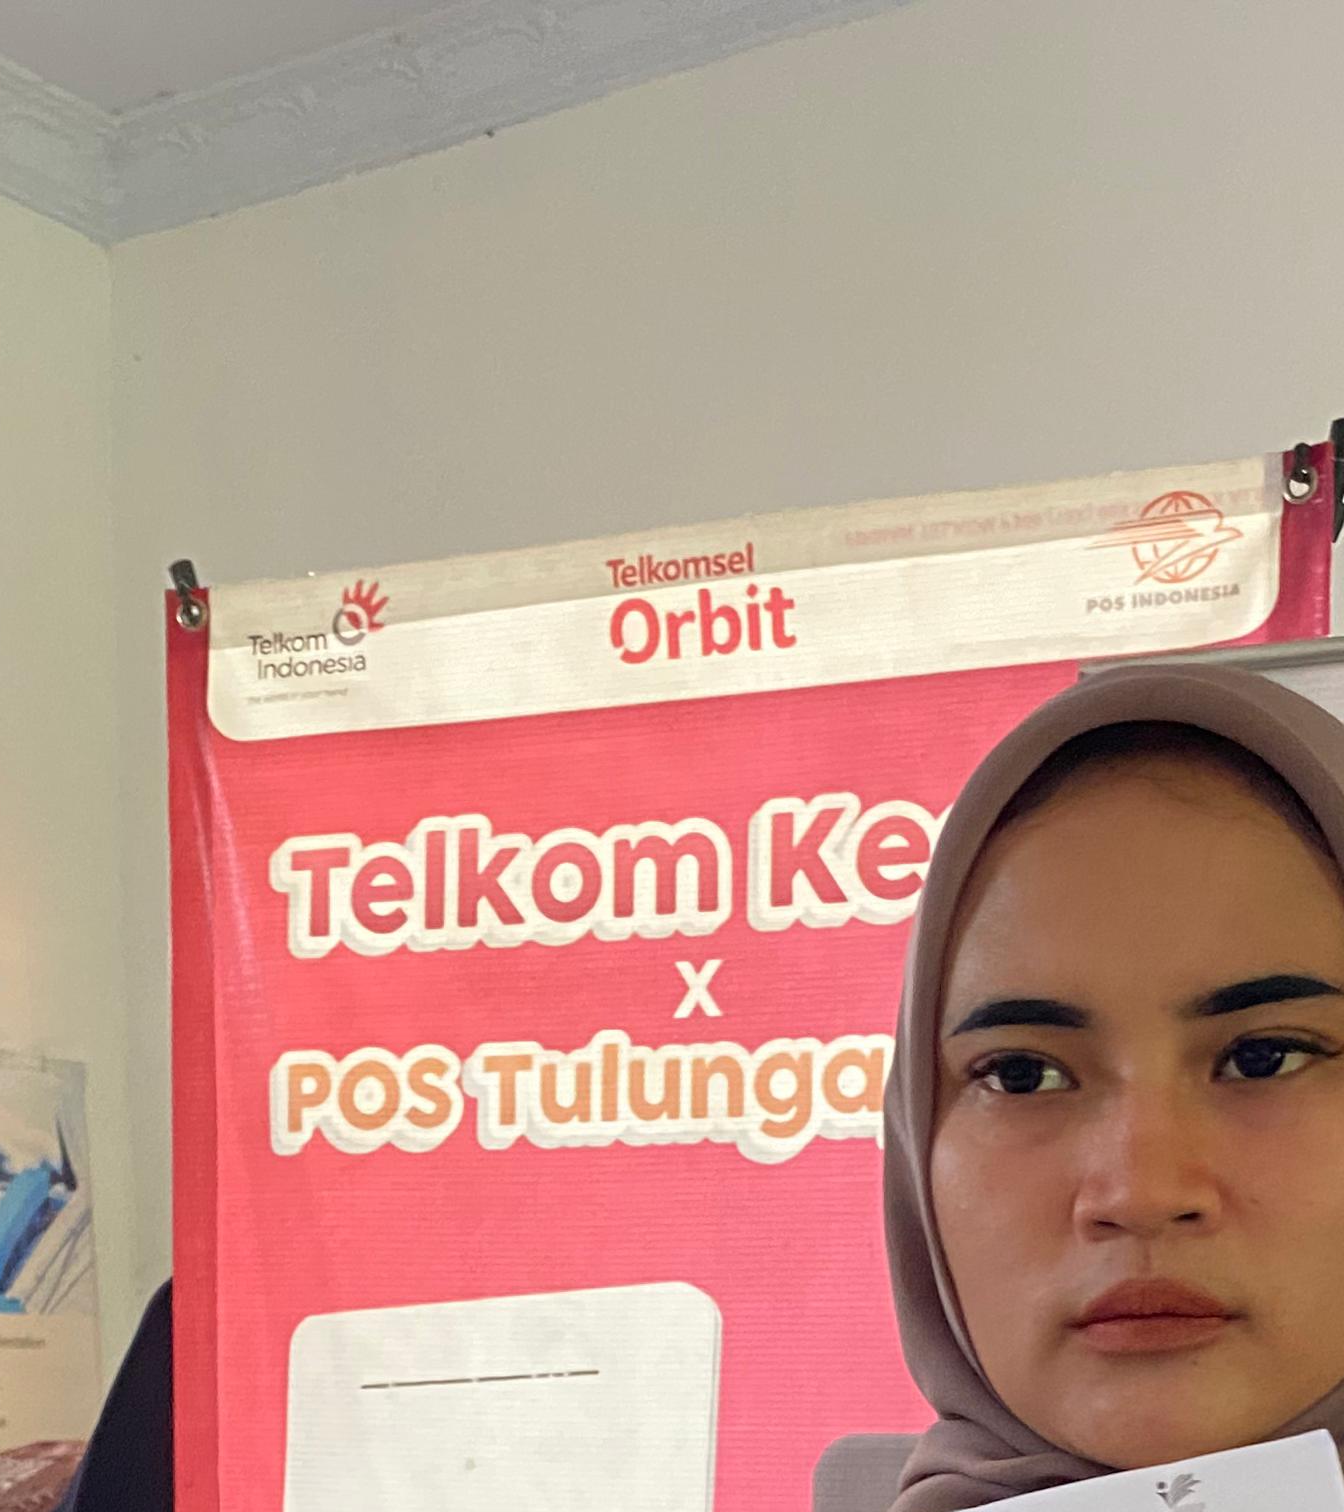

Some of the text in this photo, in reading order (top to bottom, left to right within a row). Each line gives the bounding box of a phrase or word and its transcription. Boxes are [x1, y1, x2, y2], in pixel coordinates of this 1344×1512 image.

[606, 542, 754, 588] Telkomsel
[1086, 584, 1241, 613] POS INDONESIA
[247, 632, 328, 655] Telkom
[610, 584, 797, 665] Orbit
[257, 654, 367, 680] Indonesia
[286, 814, 724, 942] Telkom
[286, 1056, 455, 1136] POS
